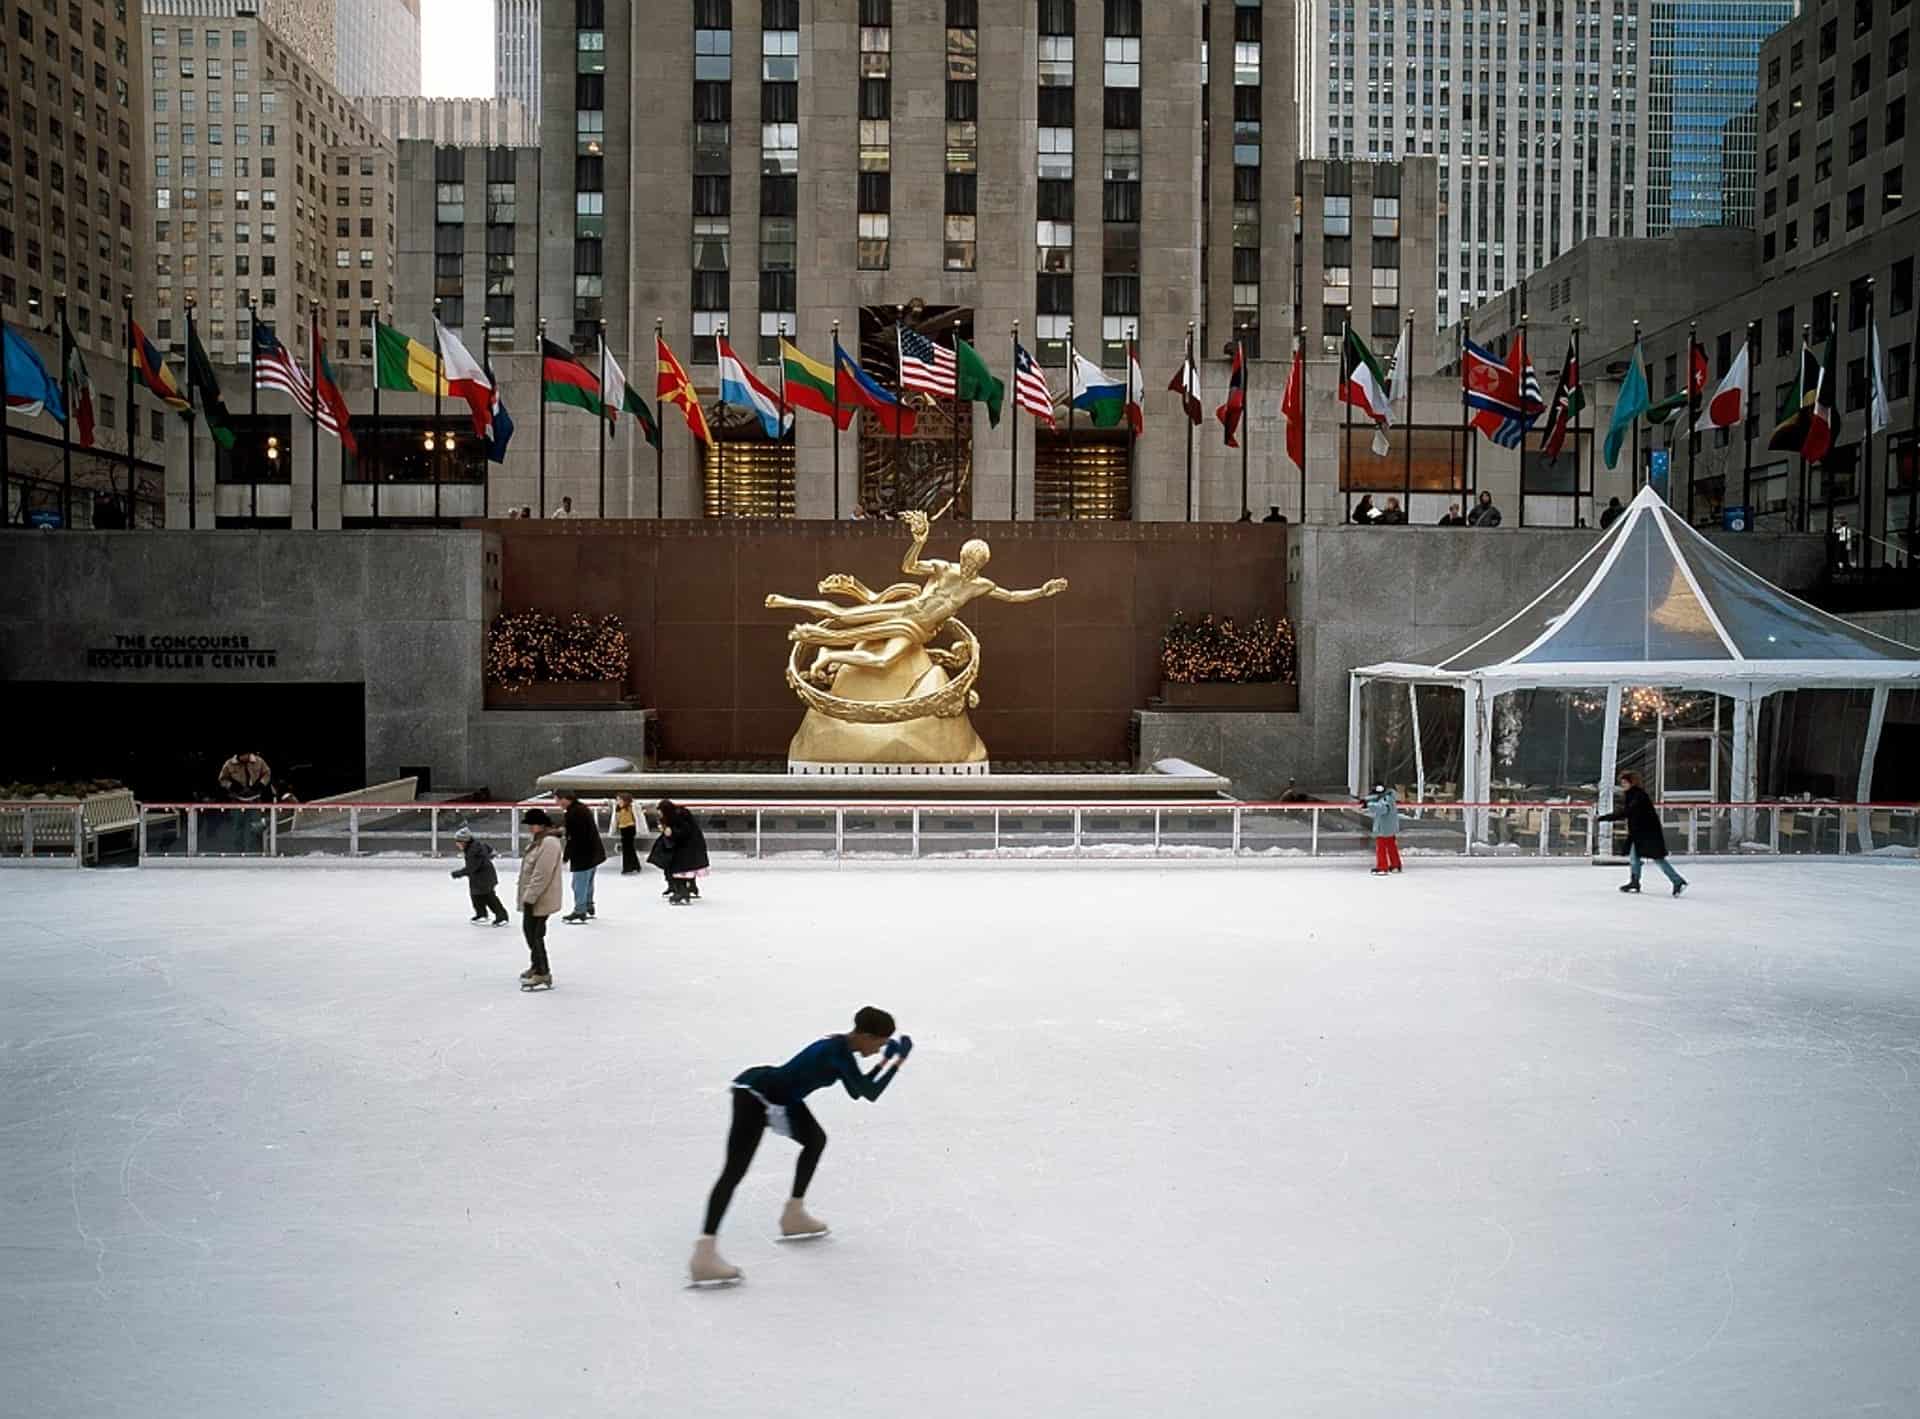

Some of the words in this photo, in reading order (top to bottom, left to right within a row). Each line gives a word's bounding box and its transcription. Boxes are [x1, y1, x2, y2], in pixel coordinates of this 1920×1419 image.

[114, 635, 144, 648] THE
[150, 635, 248, 648] CONCOURSE
[88, 654, 204, 668] ROCKEFELLER
[211, 654, 277, 668] CENTER
